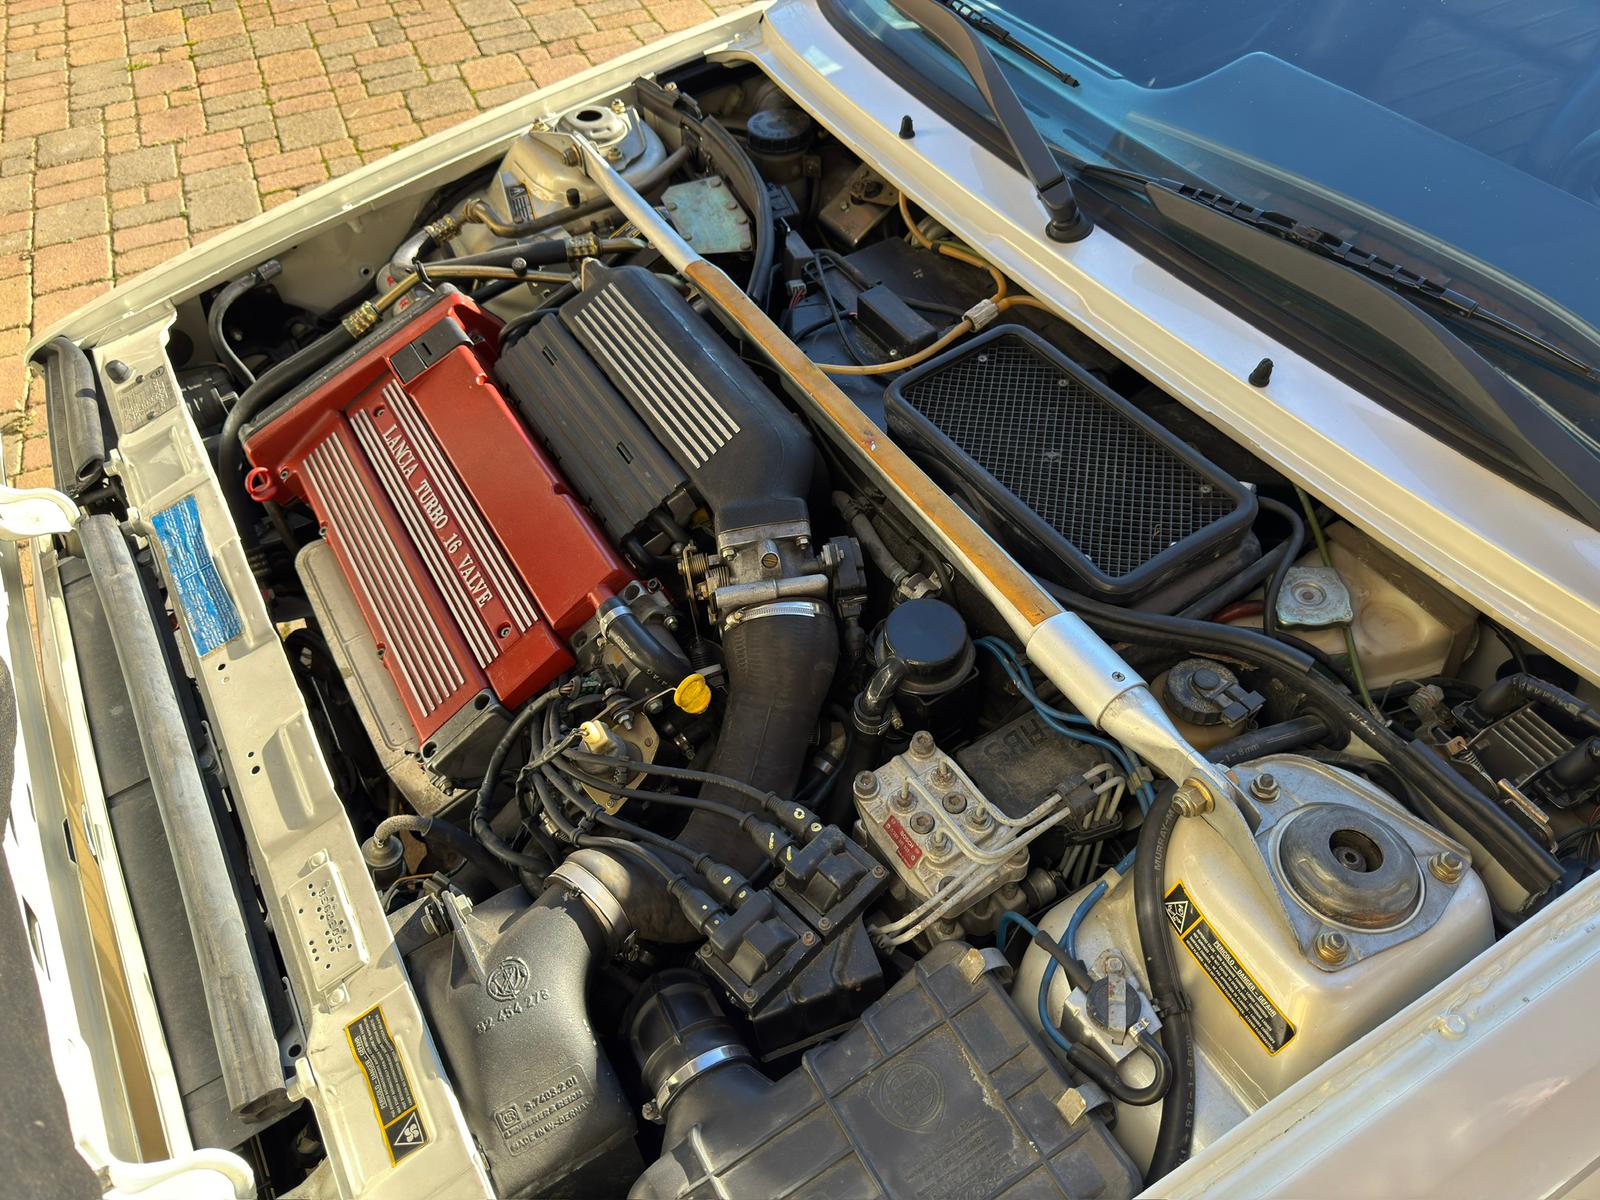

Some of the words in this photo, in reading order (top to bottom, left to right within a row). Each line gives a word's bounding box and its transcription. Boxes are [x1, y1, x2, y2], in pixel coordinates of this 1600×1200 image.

[383, 424, 419, 479] LANCIA
[414, 480, 449, 530] TURBO
[443, 533, 463, 554] 16
[457, 554, 493, 606] VALVE
[984, 720, 1046, 761] ABS
[900, 830, 913, 848] BOSCH
[1213, 940, 1235, 965] PERICOLO
[1236, 969, 1255, 991] DANGER
[1257, 994, 1276, 1017] GEFAHR
